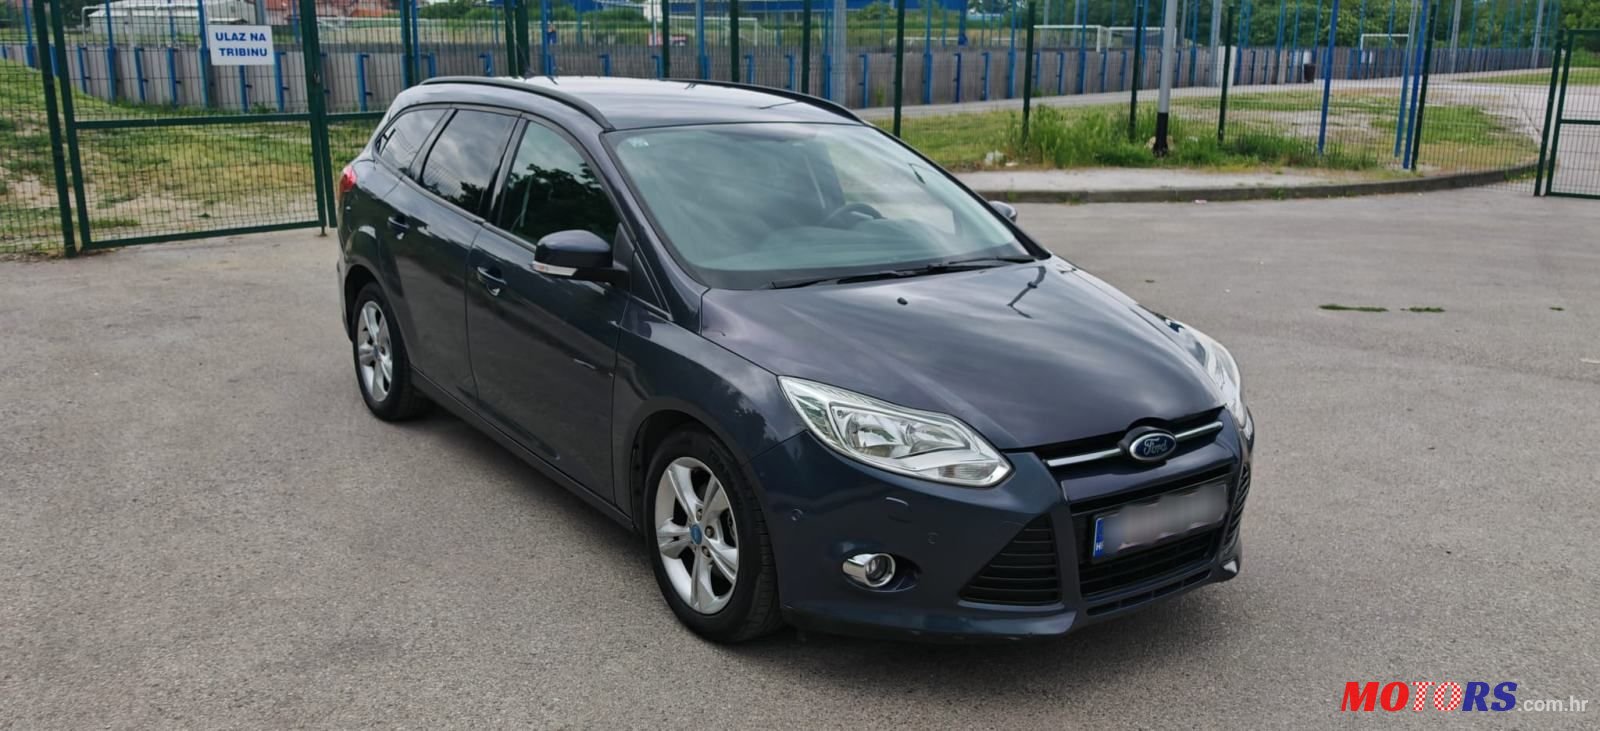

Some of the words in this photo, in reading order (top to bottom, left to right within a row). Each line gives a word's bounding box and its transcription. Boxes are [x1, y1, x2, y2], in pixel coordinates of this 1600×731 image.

[215, 32, 246, 41] ULAZ
[250, 32, 266, 41] NA
[219, 48, 267, 56] TRIBINU
[1144, 437, 1167, 455] Ford
